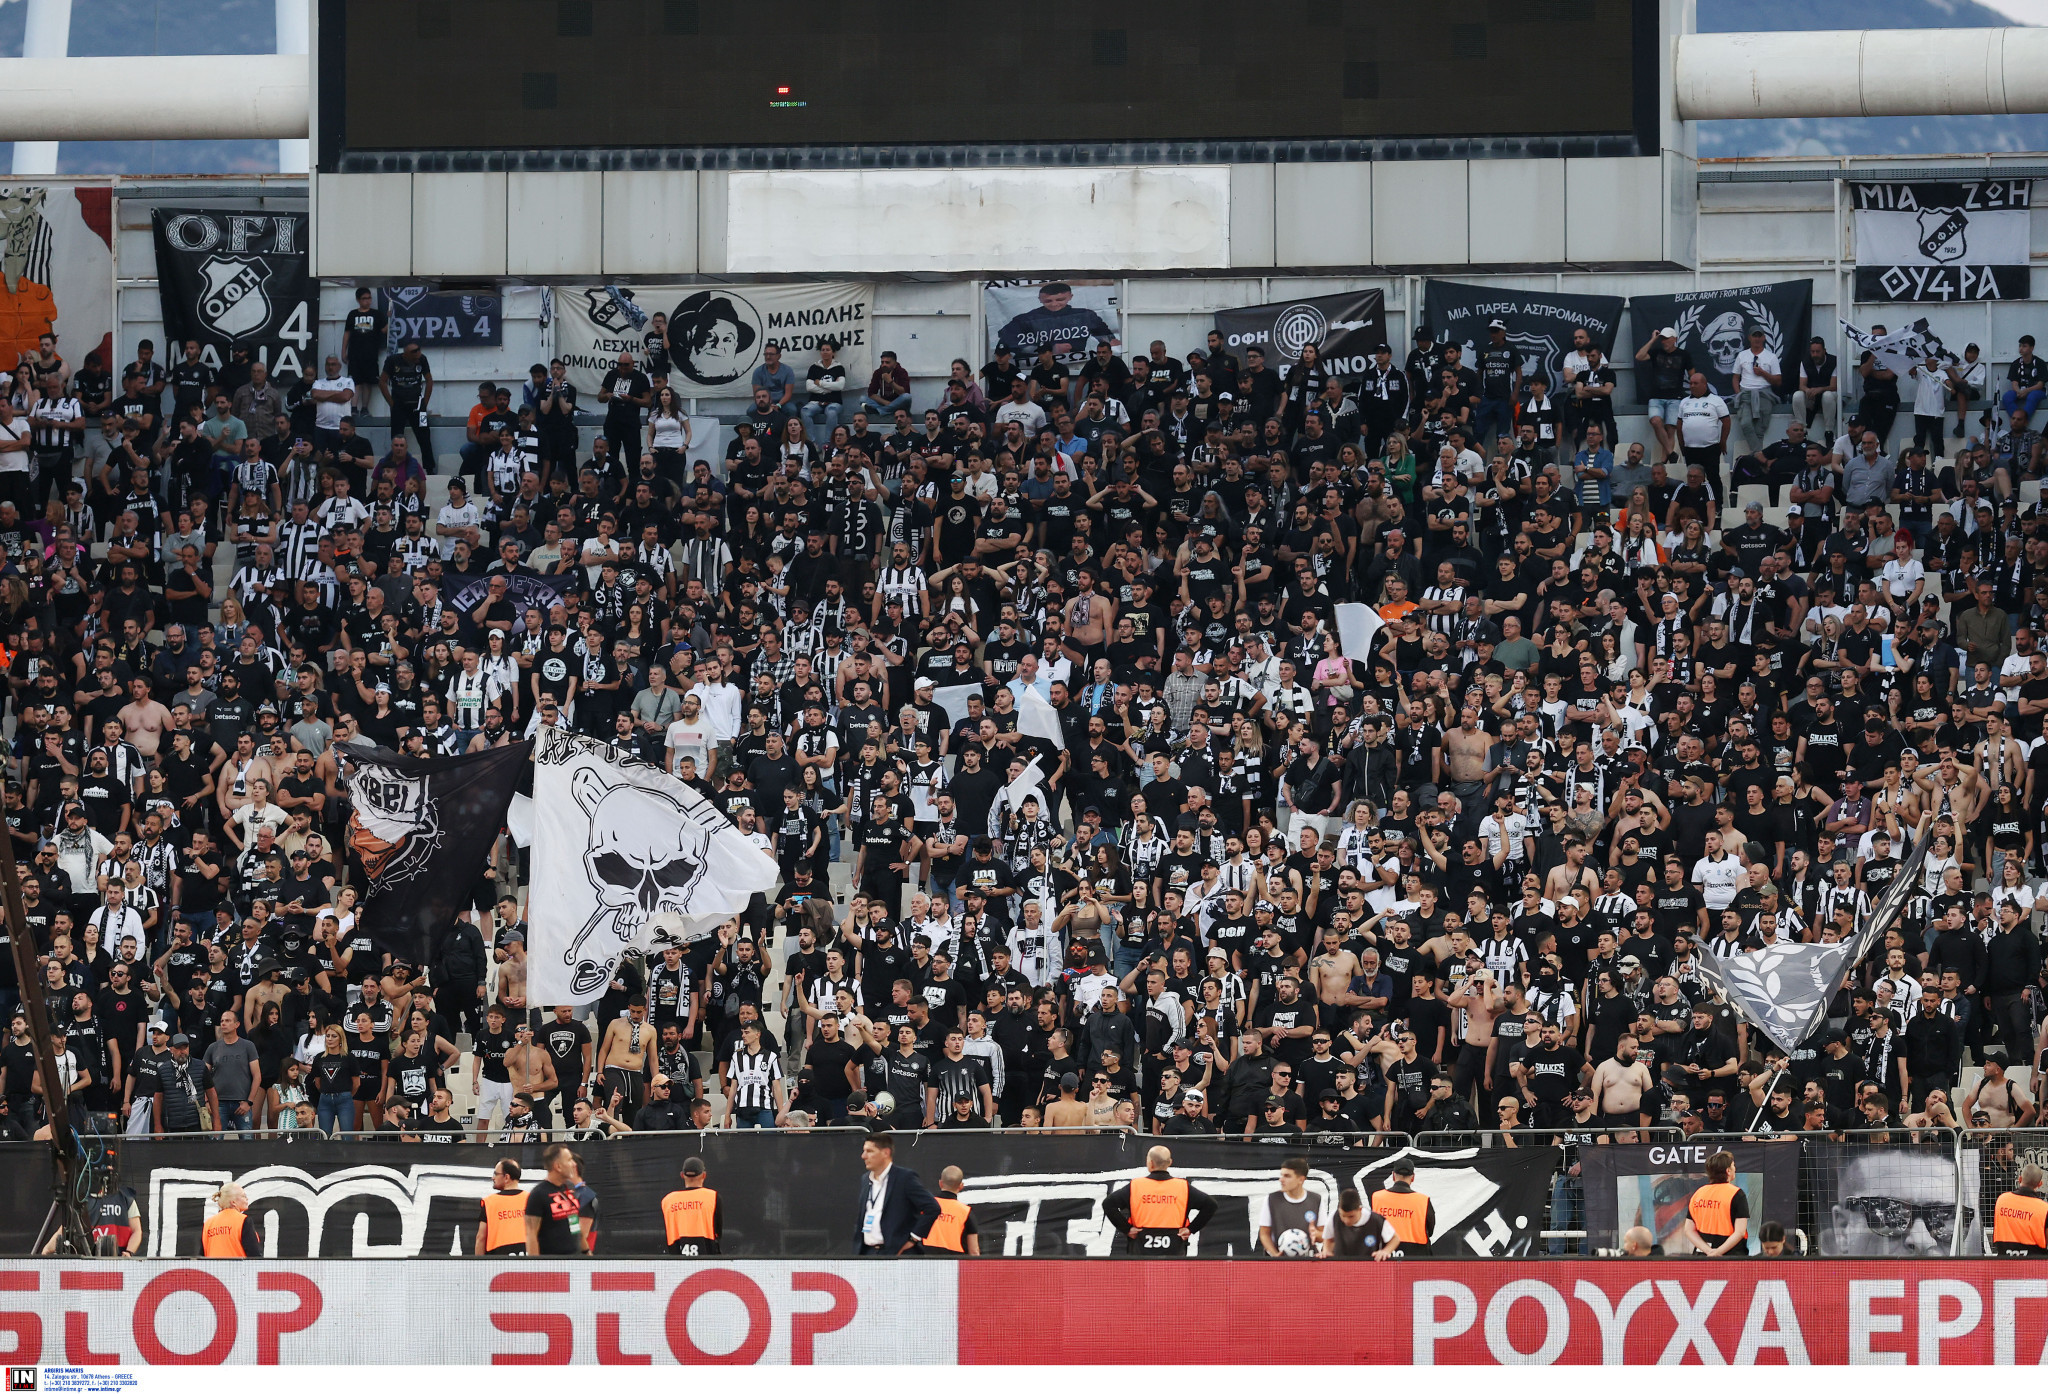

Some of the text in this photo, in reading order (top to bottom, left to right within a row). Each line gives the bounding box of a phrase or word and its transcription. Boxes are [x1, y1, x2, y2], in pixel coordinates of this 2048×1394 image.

[166, 214, 304, 254] O.F.I.
[1674, 285, 1773, 303] BLACK ARMY FROM THE SOUTH
[768, 303, 865, 329] ΜΑΝΩΛΗΣ
[1447, 302, 1608, 334] ΜΙΑ ΠΑΡΕΑ ΑΣΠΡΟΜΑΥΡΗ
[279, 300, 312, 351] 4
[473, 316, 491, 337] 4
[1016, 325, 1090, 346] 28/8/2023
[1228, 330, 1269, 347] ΟΦΗ
[593, 339, 640, 353] ΛΕΣΧΗ
[214, 713, 241, 721] betsson
[1809, 733, 1838, 744] SNAKES
[1993, 820, 2019, 832] SNAKES
[888, 1014, 910, 1023] SNAKE
[891, 1066, 918, 1078] betsson
[1534, 1062, 1565, 1074] SNAKES
[423, 1134, 452, 1144] SNAKES
[1649, 1145, 1707, 1165] GATE
[671, 1200, 704, 1212] SECURITY
[1142, 1194, 1178, 1205] SECURITY
[1380, 1206, 1414, 1219] SECURITY
[2000, 1207, 2034, 1222] SECURITY
[207, 1226, 232, 1238] SECURITY
[1144, 1235, 1170, 1248] 250
[489, 1268, 858, 1365] STOP
[1412, 1279, 2048, 1365] ΡΟΥΧΑ ΕΡΓ
